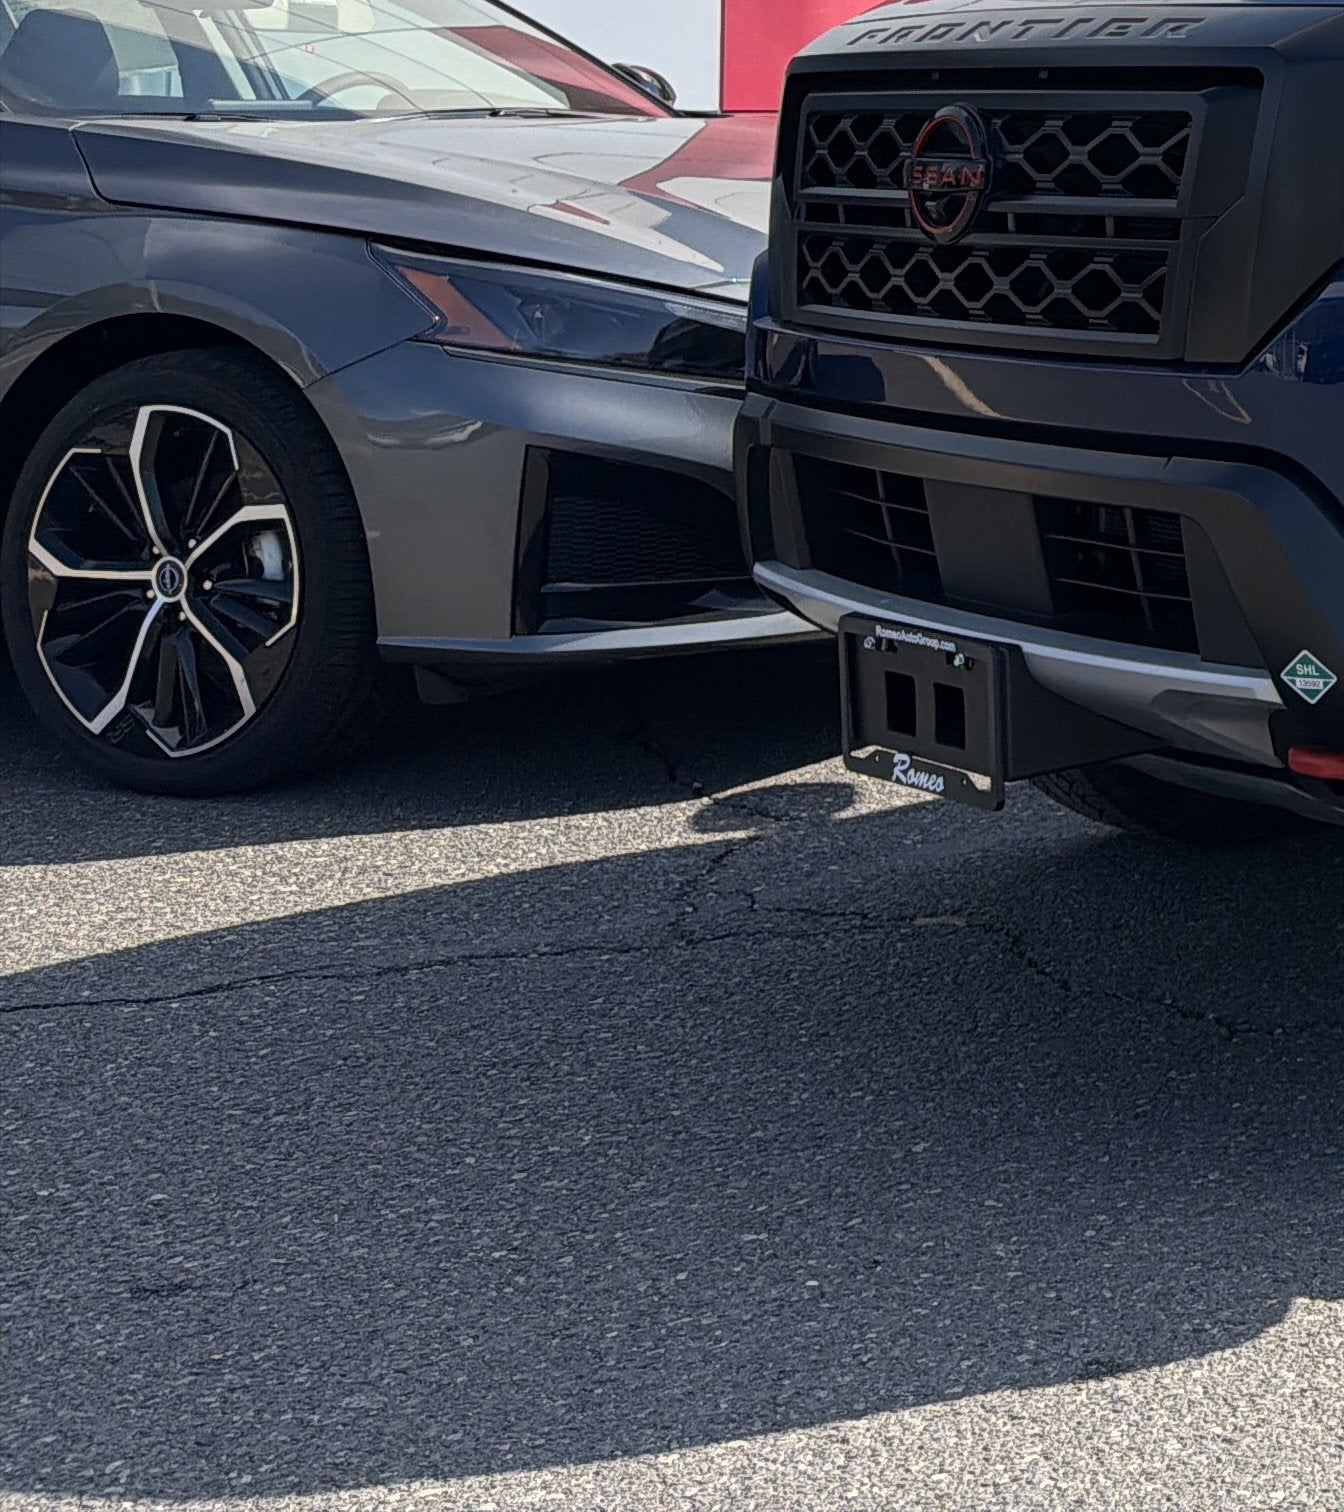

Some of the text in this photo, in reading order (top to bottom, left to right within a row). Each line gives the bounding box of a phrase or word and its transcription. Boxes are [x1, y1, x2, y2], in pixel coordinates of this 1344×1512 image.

[847, 16, 1207, 47] FRONTIER
[1295, 663, 1321, 676] SHL
[891, 752, 945, 793] Romeo
